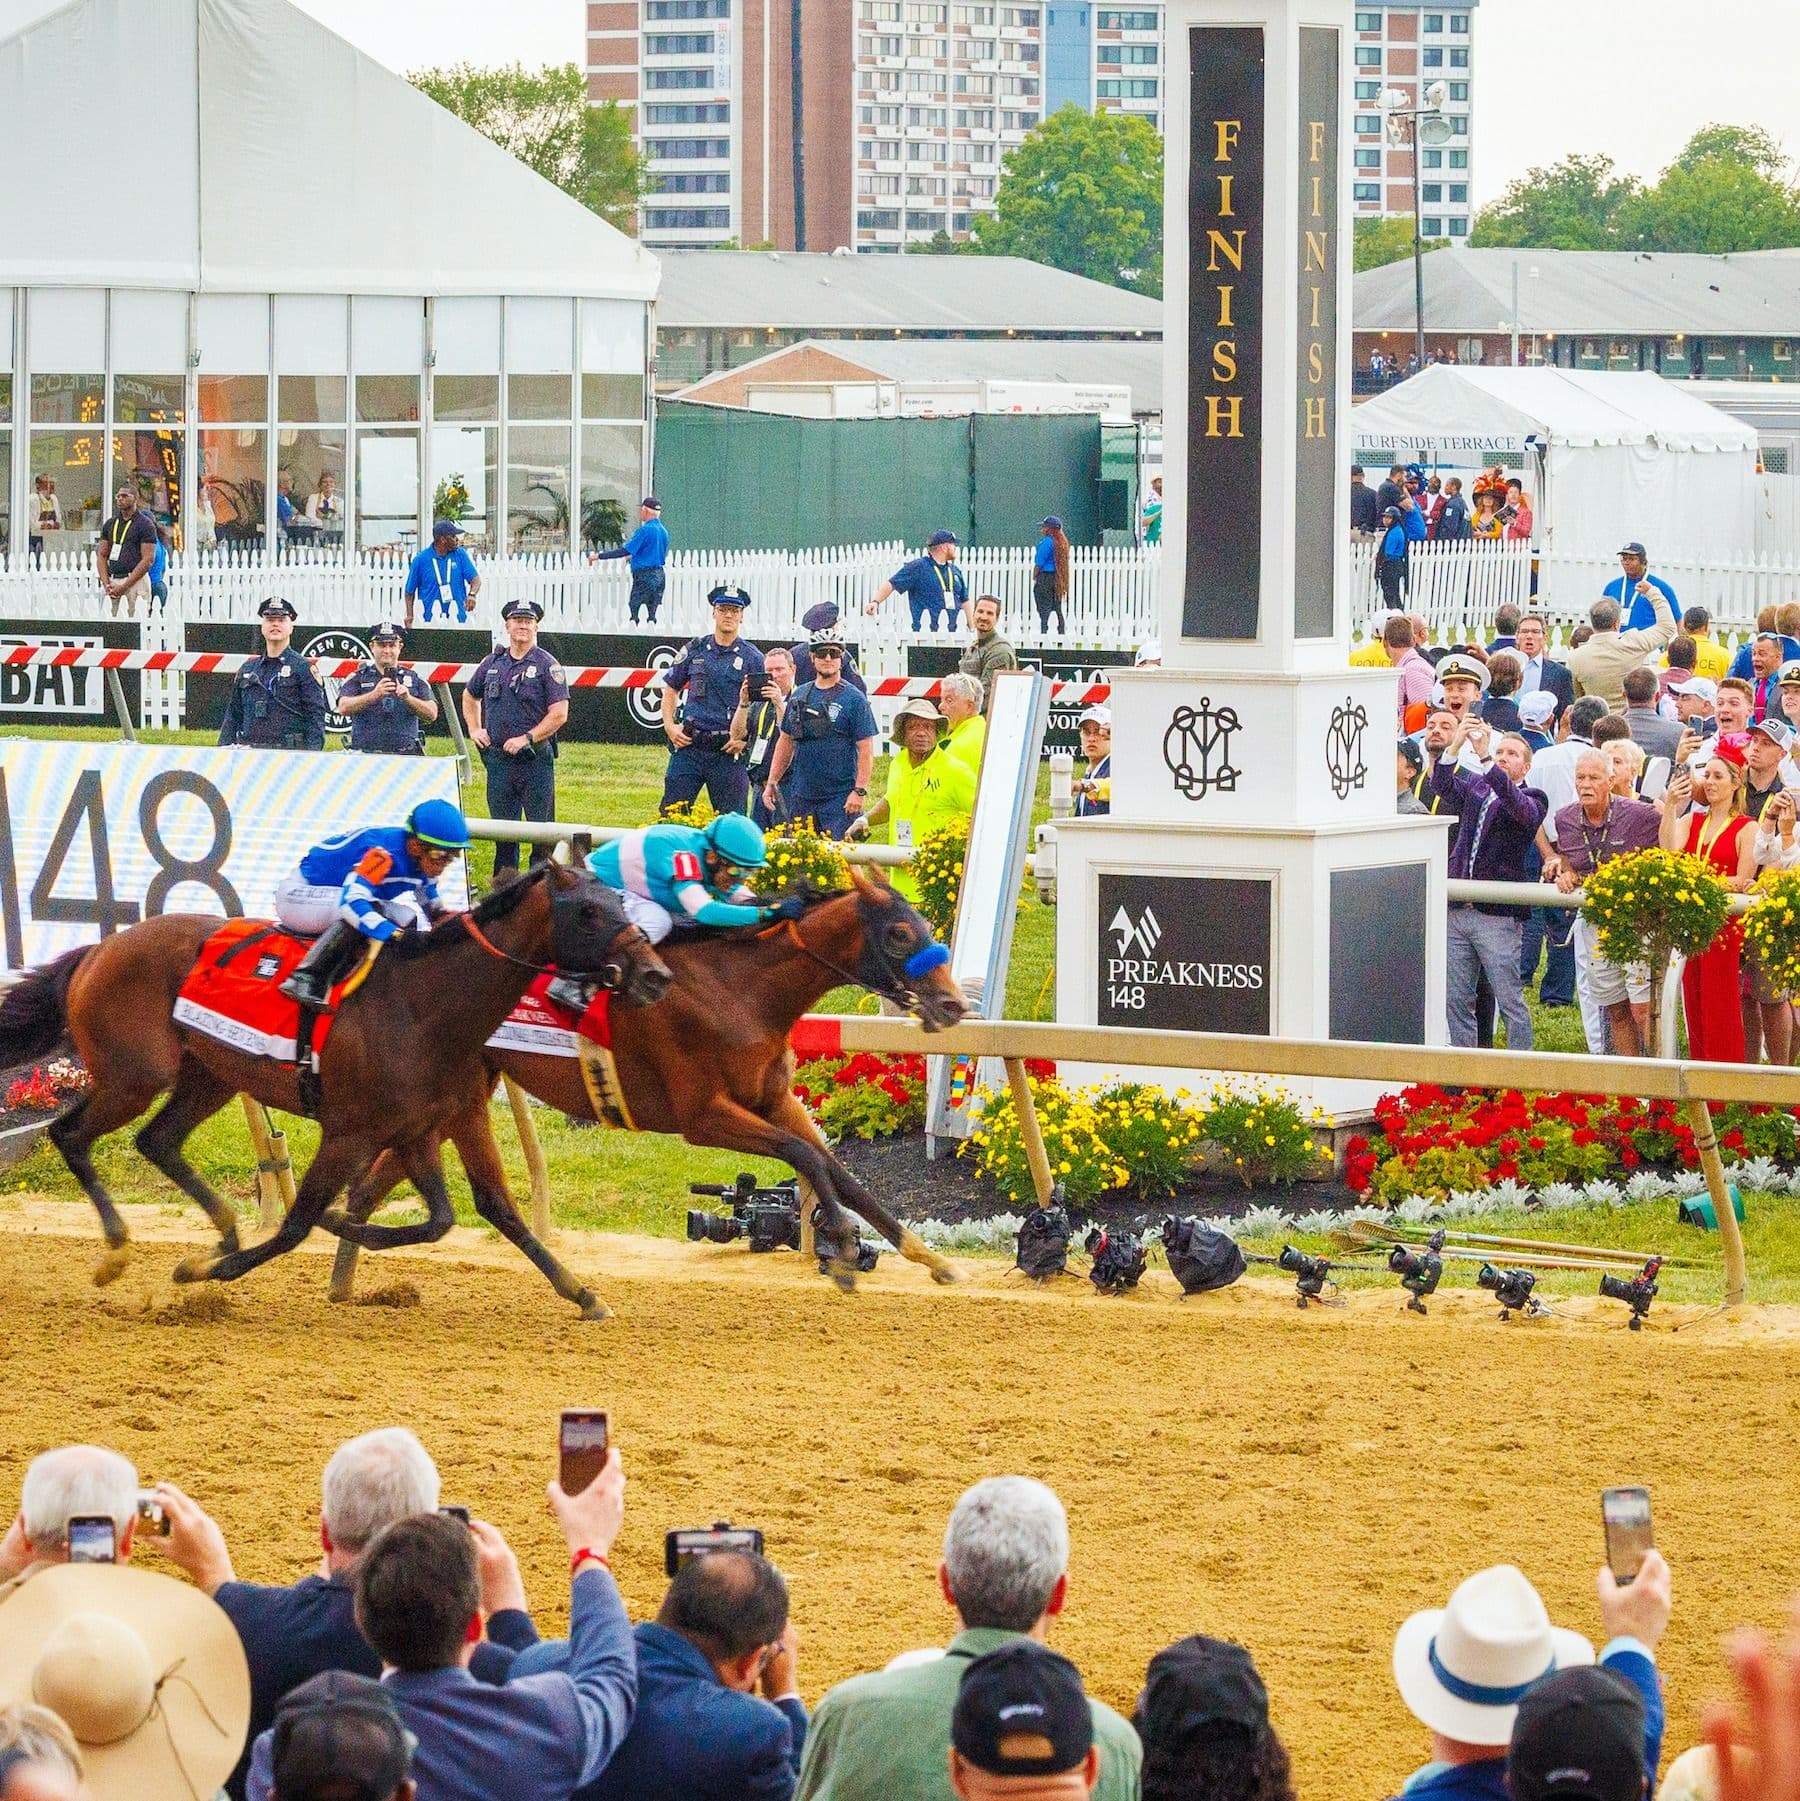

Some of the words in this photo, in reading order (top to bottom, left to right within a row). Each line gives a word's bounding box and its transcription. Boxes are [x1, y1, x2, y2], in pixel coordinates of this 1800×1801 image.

[1204, 120, 1246, 437] FINISH
[1304, 121, 1327, 438] FINISH
[1358, 434, 1437, 450] TURFSIDE
[1440, 437, 1516, 451] TERRACE
[309, 639, 334, 658] PEN
[1047, 714, 1081, 730] VOD
[680, 853, 693, 877] 1
[1107, 958, 1264, 989] PREAKNESS
[1107, 986, 1146, 1010] 148
